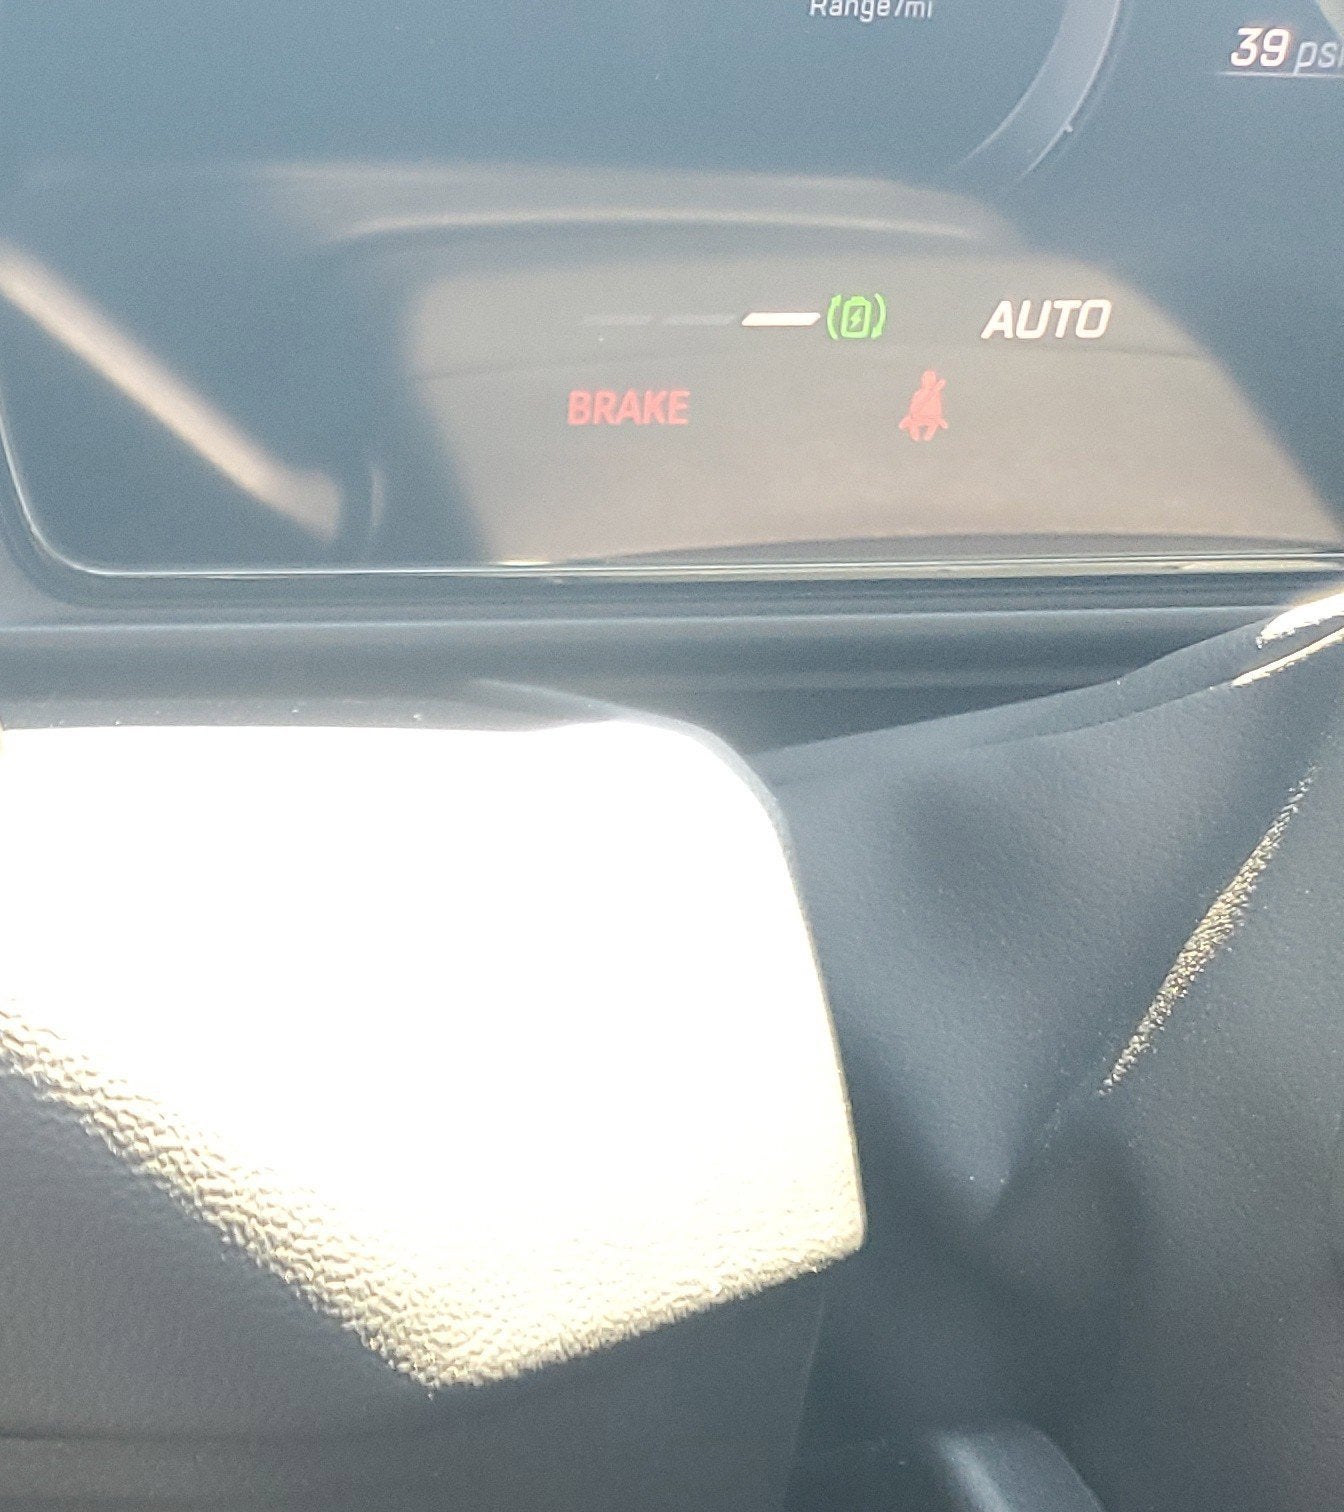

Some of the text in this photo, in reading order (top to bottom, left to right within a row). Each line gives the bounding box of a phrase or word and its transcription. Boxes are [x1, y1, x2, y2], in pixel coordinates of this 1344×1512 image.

[1231, 27, 1291, 67] 39
[981, 298, 1112, 340] AUTO
[568, 388, 690, 426] BRAKE
